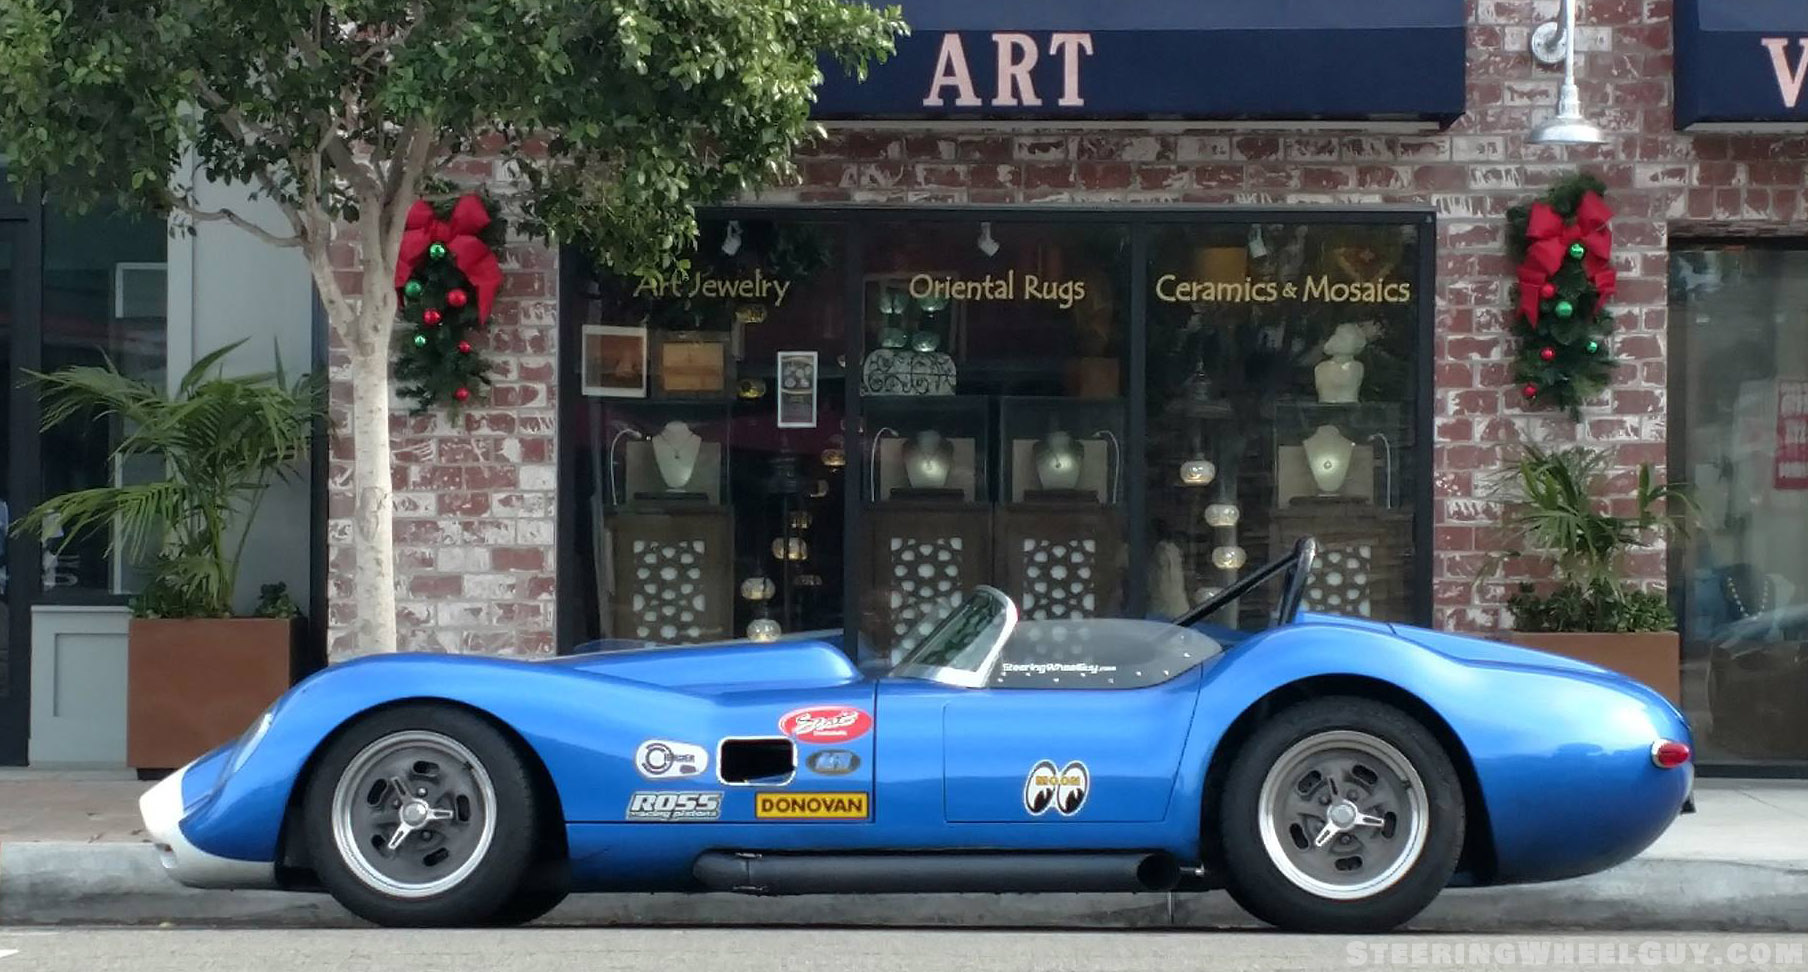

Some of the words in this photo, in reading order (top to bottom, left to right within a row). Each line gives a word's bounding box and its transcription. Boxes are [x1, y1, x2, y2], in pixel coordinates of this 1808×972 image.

[922, 32, 1094, 107] ART
[632, 269, 681, 298] Art
[687, 268, 791, 307] Jewelry
[909, 269, 1014, 300] Oriental
[1024, 274, 1086, 309] Rugs
[1155, 274, 1278, 302] Ceramics
[1282, 282, 1298, 298] &
[1302, 274, 1411, 303] Mosaics
[631, 794, 720, 811] ROSS
[761, 797, 863, 813] DONOVAN
